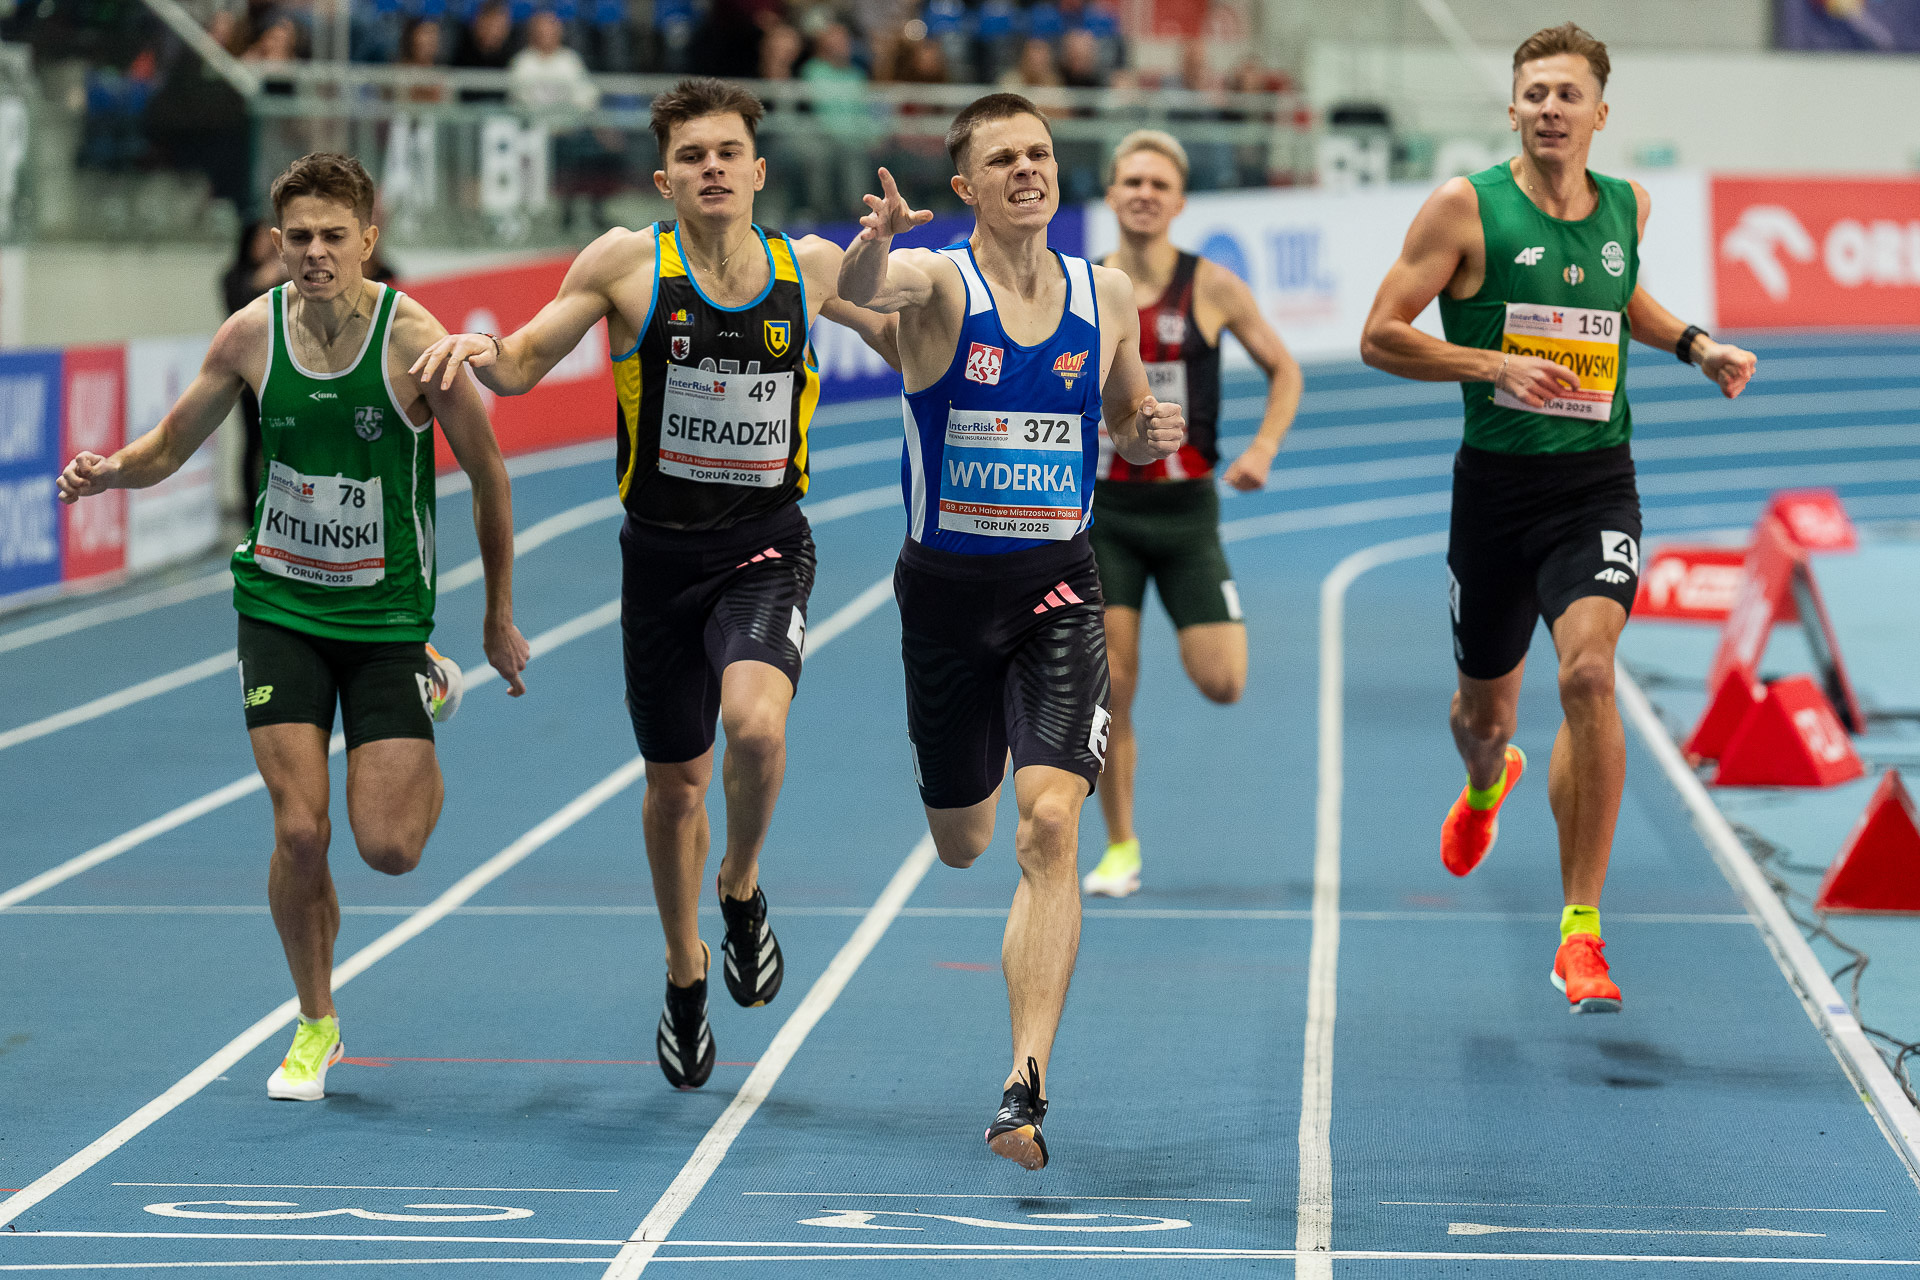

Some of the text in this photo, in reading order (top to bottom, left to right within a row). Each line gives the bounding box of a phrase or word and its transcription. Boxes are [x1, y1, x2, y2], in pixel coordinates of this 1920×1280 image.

[1514, 246, 1545, 266] 4F
[1579, 314, 1613, 336] 150
[1053, 350, 1088, 371] AWF
[668, 377, 712, 393] InterRisk
[748, 380, 777, 402] 49
[667, 413, 787, 446] SIERADZKI
[948, 420, 995, 432] InterRisk
[1024, 419, 1070, 444] 372
[676, 454, 693, 463] PZLA
[723, 460, 768, 469] Mistrzostwa
[689, 468, 761, 482] TORUŃ 2025
[948, 459, 1076, 493] WYDERKA
[339, 484, 366, 508] 78
[945, 503, 1078, 518] 69. PZLA Halowe Mistrzostwa Polski
[266, 508, 378, 549] KITLIŃSKI
[973, 519, 1049, 533] TORUŃ 2025
[1613, 538, 1633, 564] 4
[285, 565, 353, 583] TORUŃ 2025
[1594, 567, 1630, 585] 4F
[143, 1200, 535, 1222] 3
[796, 1209, 1193, 1233] 2
